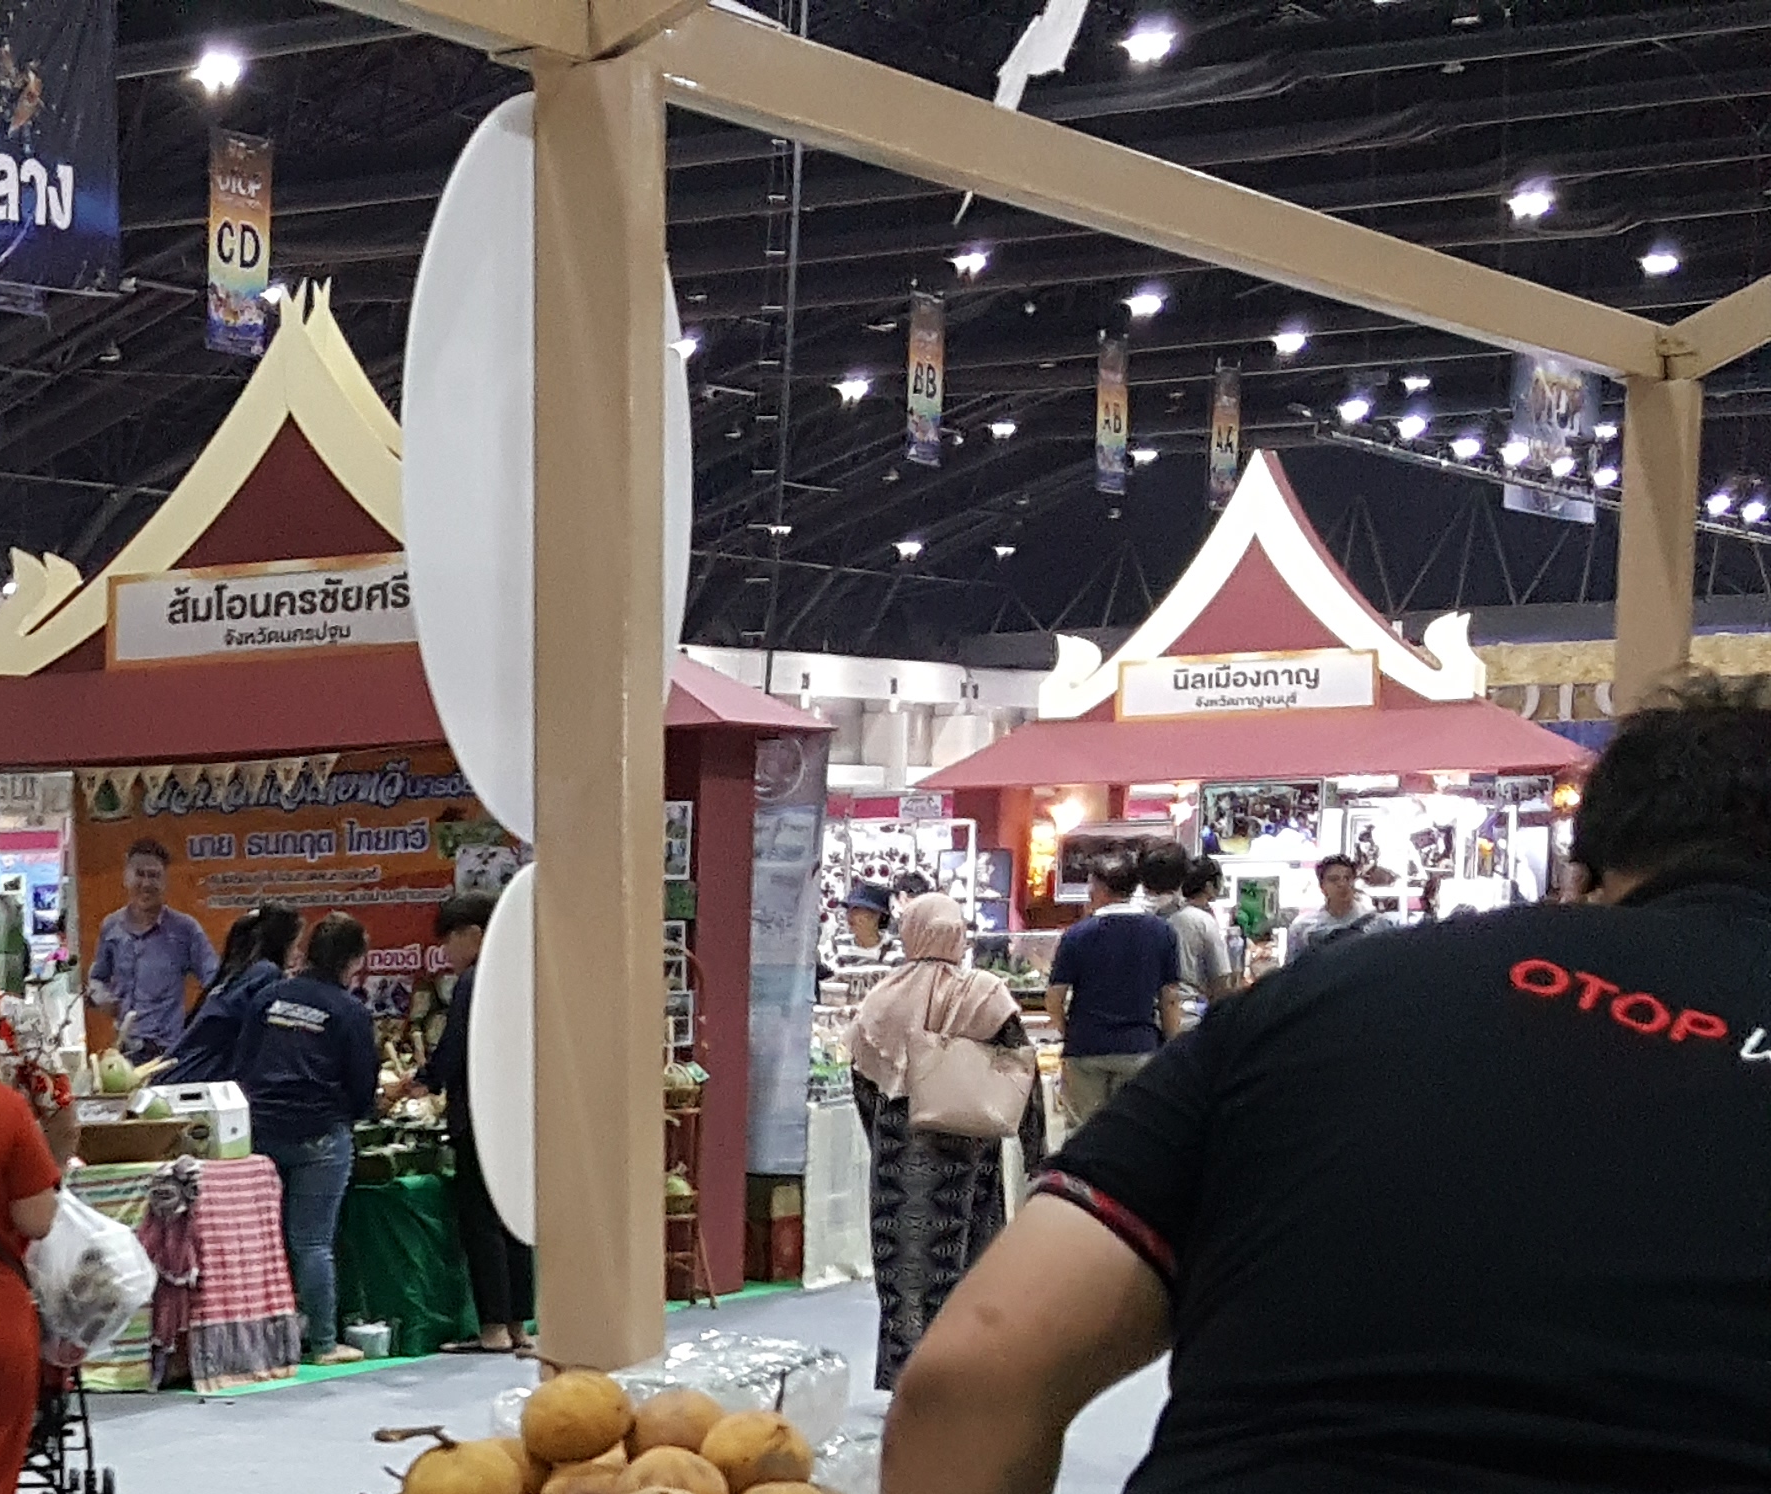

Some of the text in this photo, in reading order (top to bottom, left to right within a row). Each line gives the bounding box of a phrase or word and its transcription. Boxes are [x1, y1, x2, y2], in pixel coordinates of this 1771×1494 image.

[216, 219, 262, 269] CD
[913, 362, 937, 399] BB
[166, 571, 412, 625] ส้มโอนครชัยศรี
[1172, 664, 1321, 690] นิลเมืองกาญ
[1509, 957, 1729, 1042] OTOP
